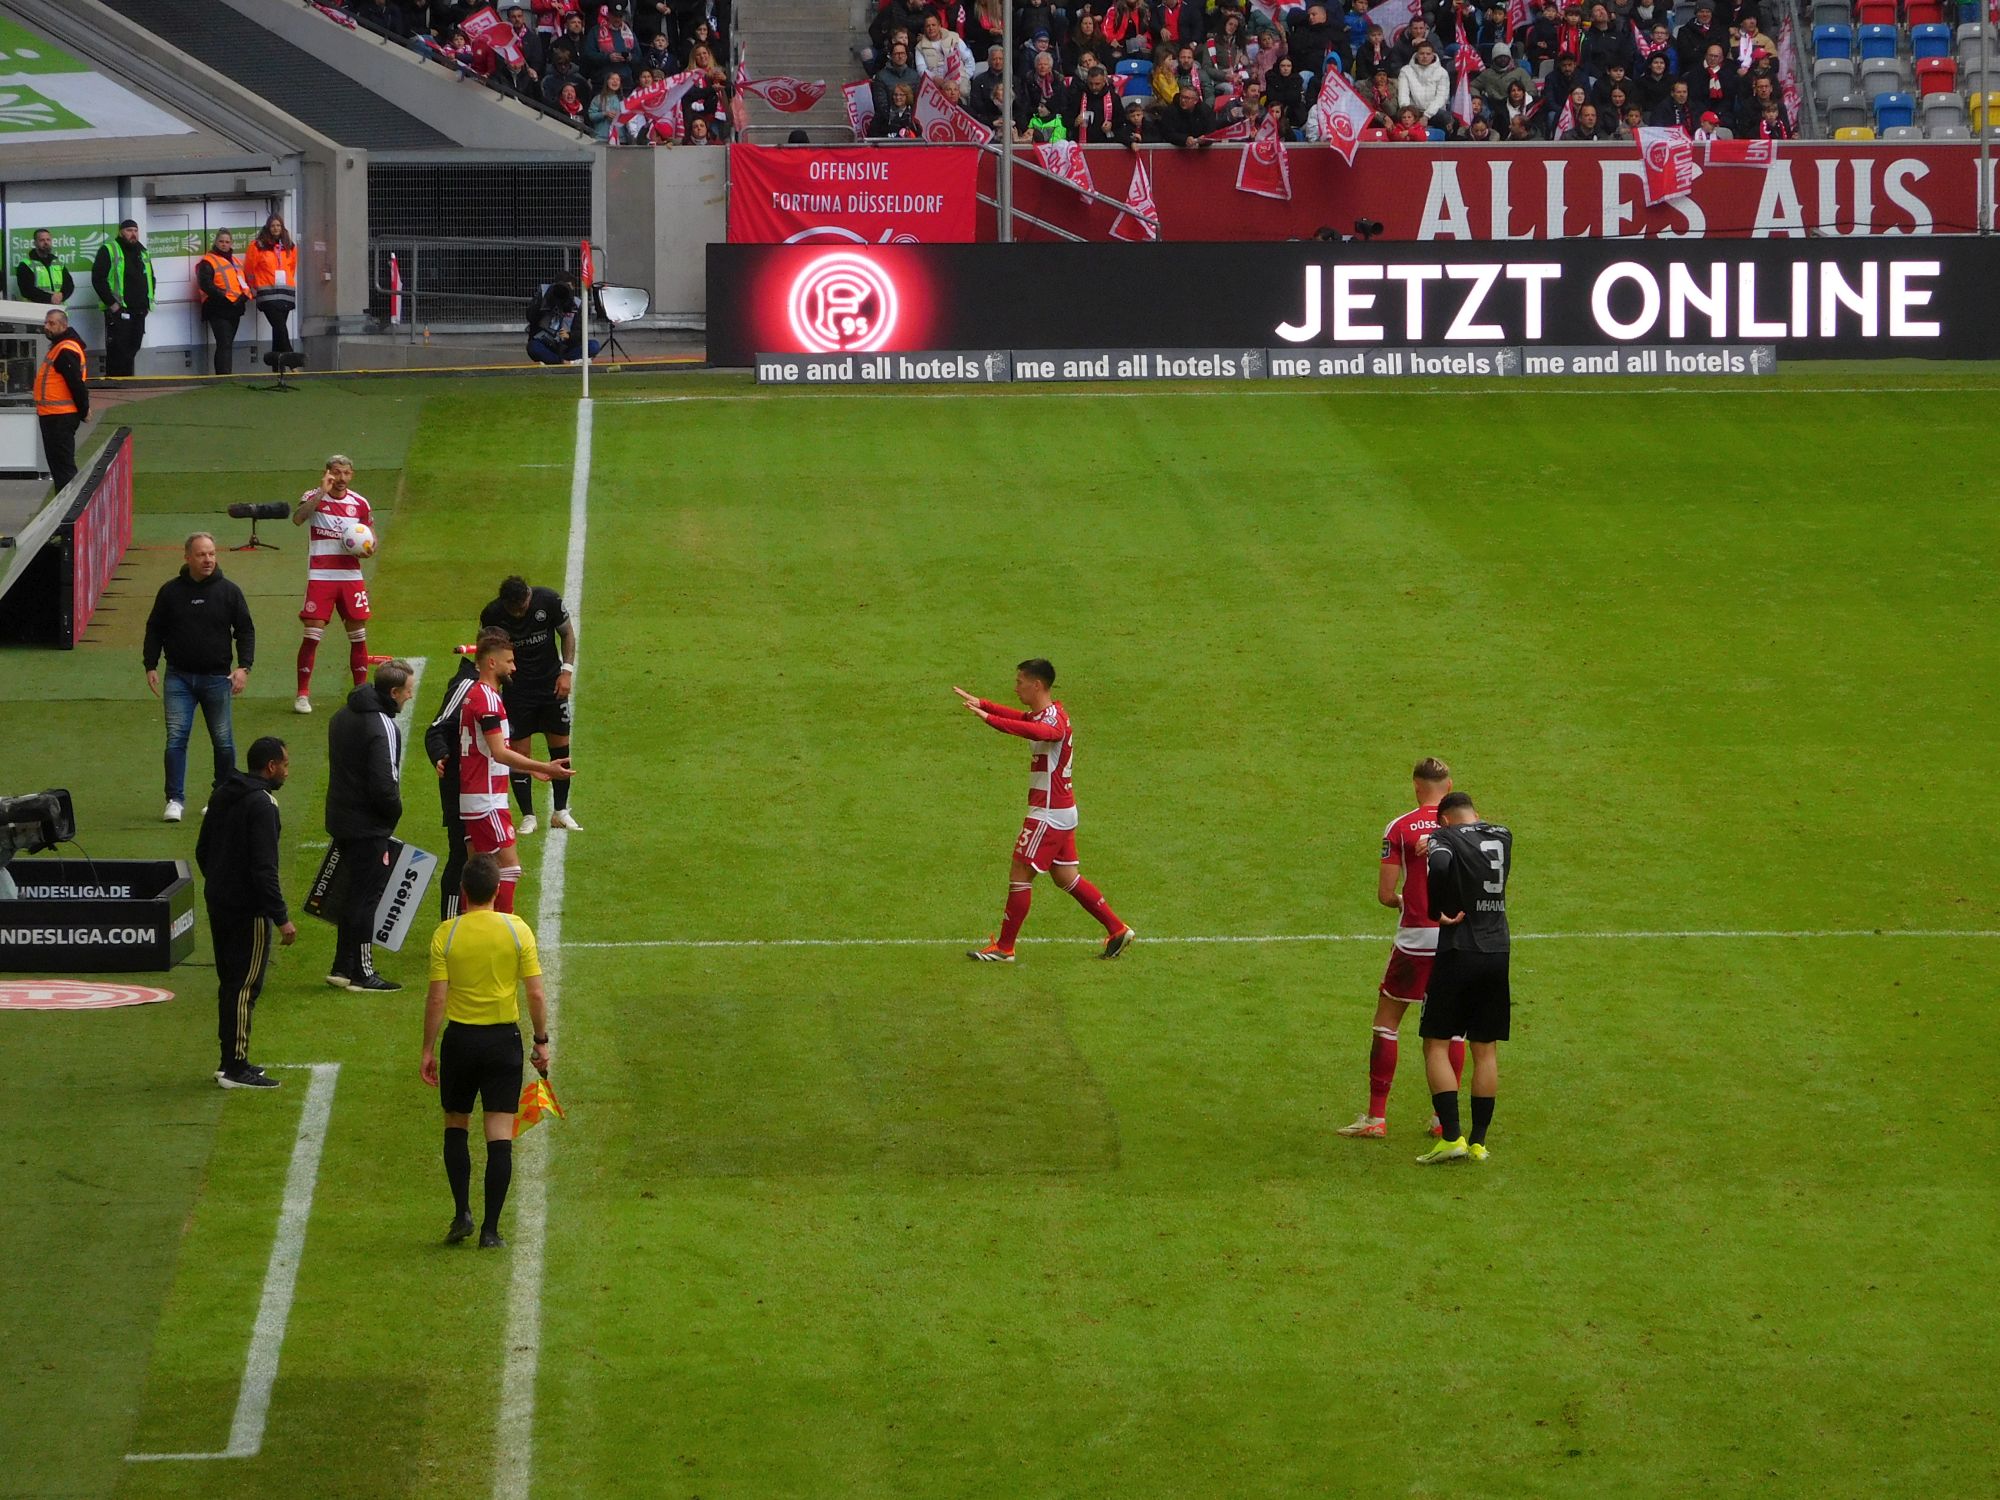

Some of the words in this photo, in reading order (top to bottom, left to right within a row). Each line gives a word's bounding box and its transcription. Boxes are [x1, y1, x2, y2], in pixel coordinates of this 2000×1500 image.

[809, 162, 889, 180] OFFENSIVE
[772, 192, 842, 213] FORTUNA
[847, 191, 944, 213] DÜSSELDORF
[1752, 158, 1933, 236] AUS
[1275, 264, 1561, 342] JETZT
[1592, 262, 1940, 340] ONLINE
[761, 364, 798, 380] me
[807, 358, 852, 380] and
[862, 357, 890, 379] all
[900, 356, 979, 379] hotels
[1017, 362, 1055, 378] me
[1064, 355, 1109, 377] and
[1118, 355, 1147, 377] all
[1157, 354, 1236, 376] hotels
[1273, 360, 1310, 375] me
[1319, 354, 1364, 375] and
[1373, 353, 1402, 374] all
[1411, 353, 1490, 374] hotels
[1526, 357, 1564, 373] me
[1573, 351, 1618, 373] and
[1627, 351, 1657, 372] all
[1666, 350, 1745, 372] hotels
[315, 528, 342, 538] TARGO
[354, 592, 368, 608] 25
[1017, 828, 1033, 847] 3
[314, 847, 341, 897] NDESLIGA
[1480, 840, 1505, 894] 3
[17, 885, 131, 898] UNDESLIGA.DE
[376, 868, 419, 943] Stölting
[0, 928, 156, 945] NDESLIGA.COM
